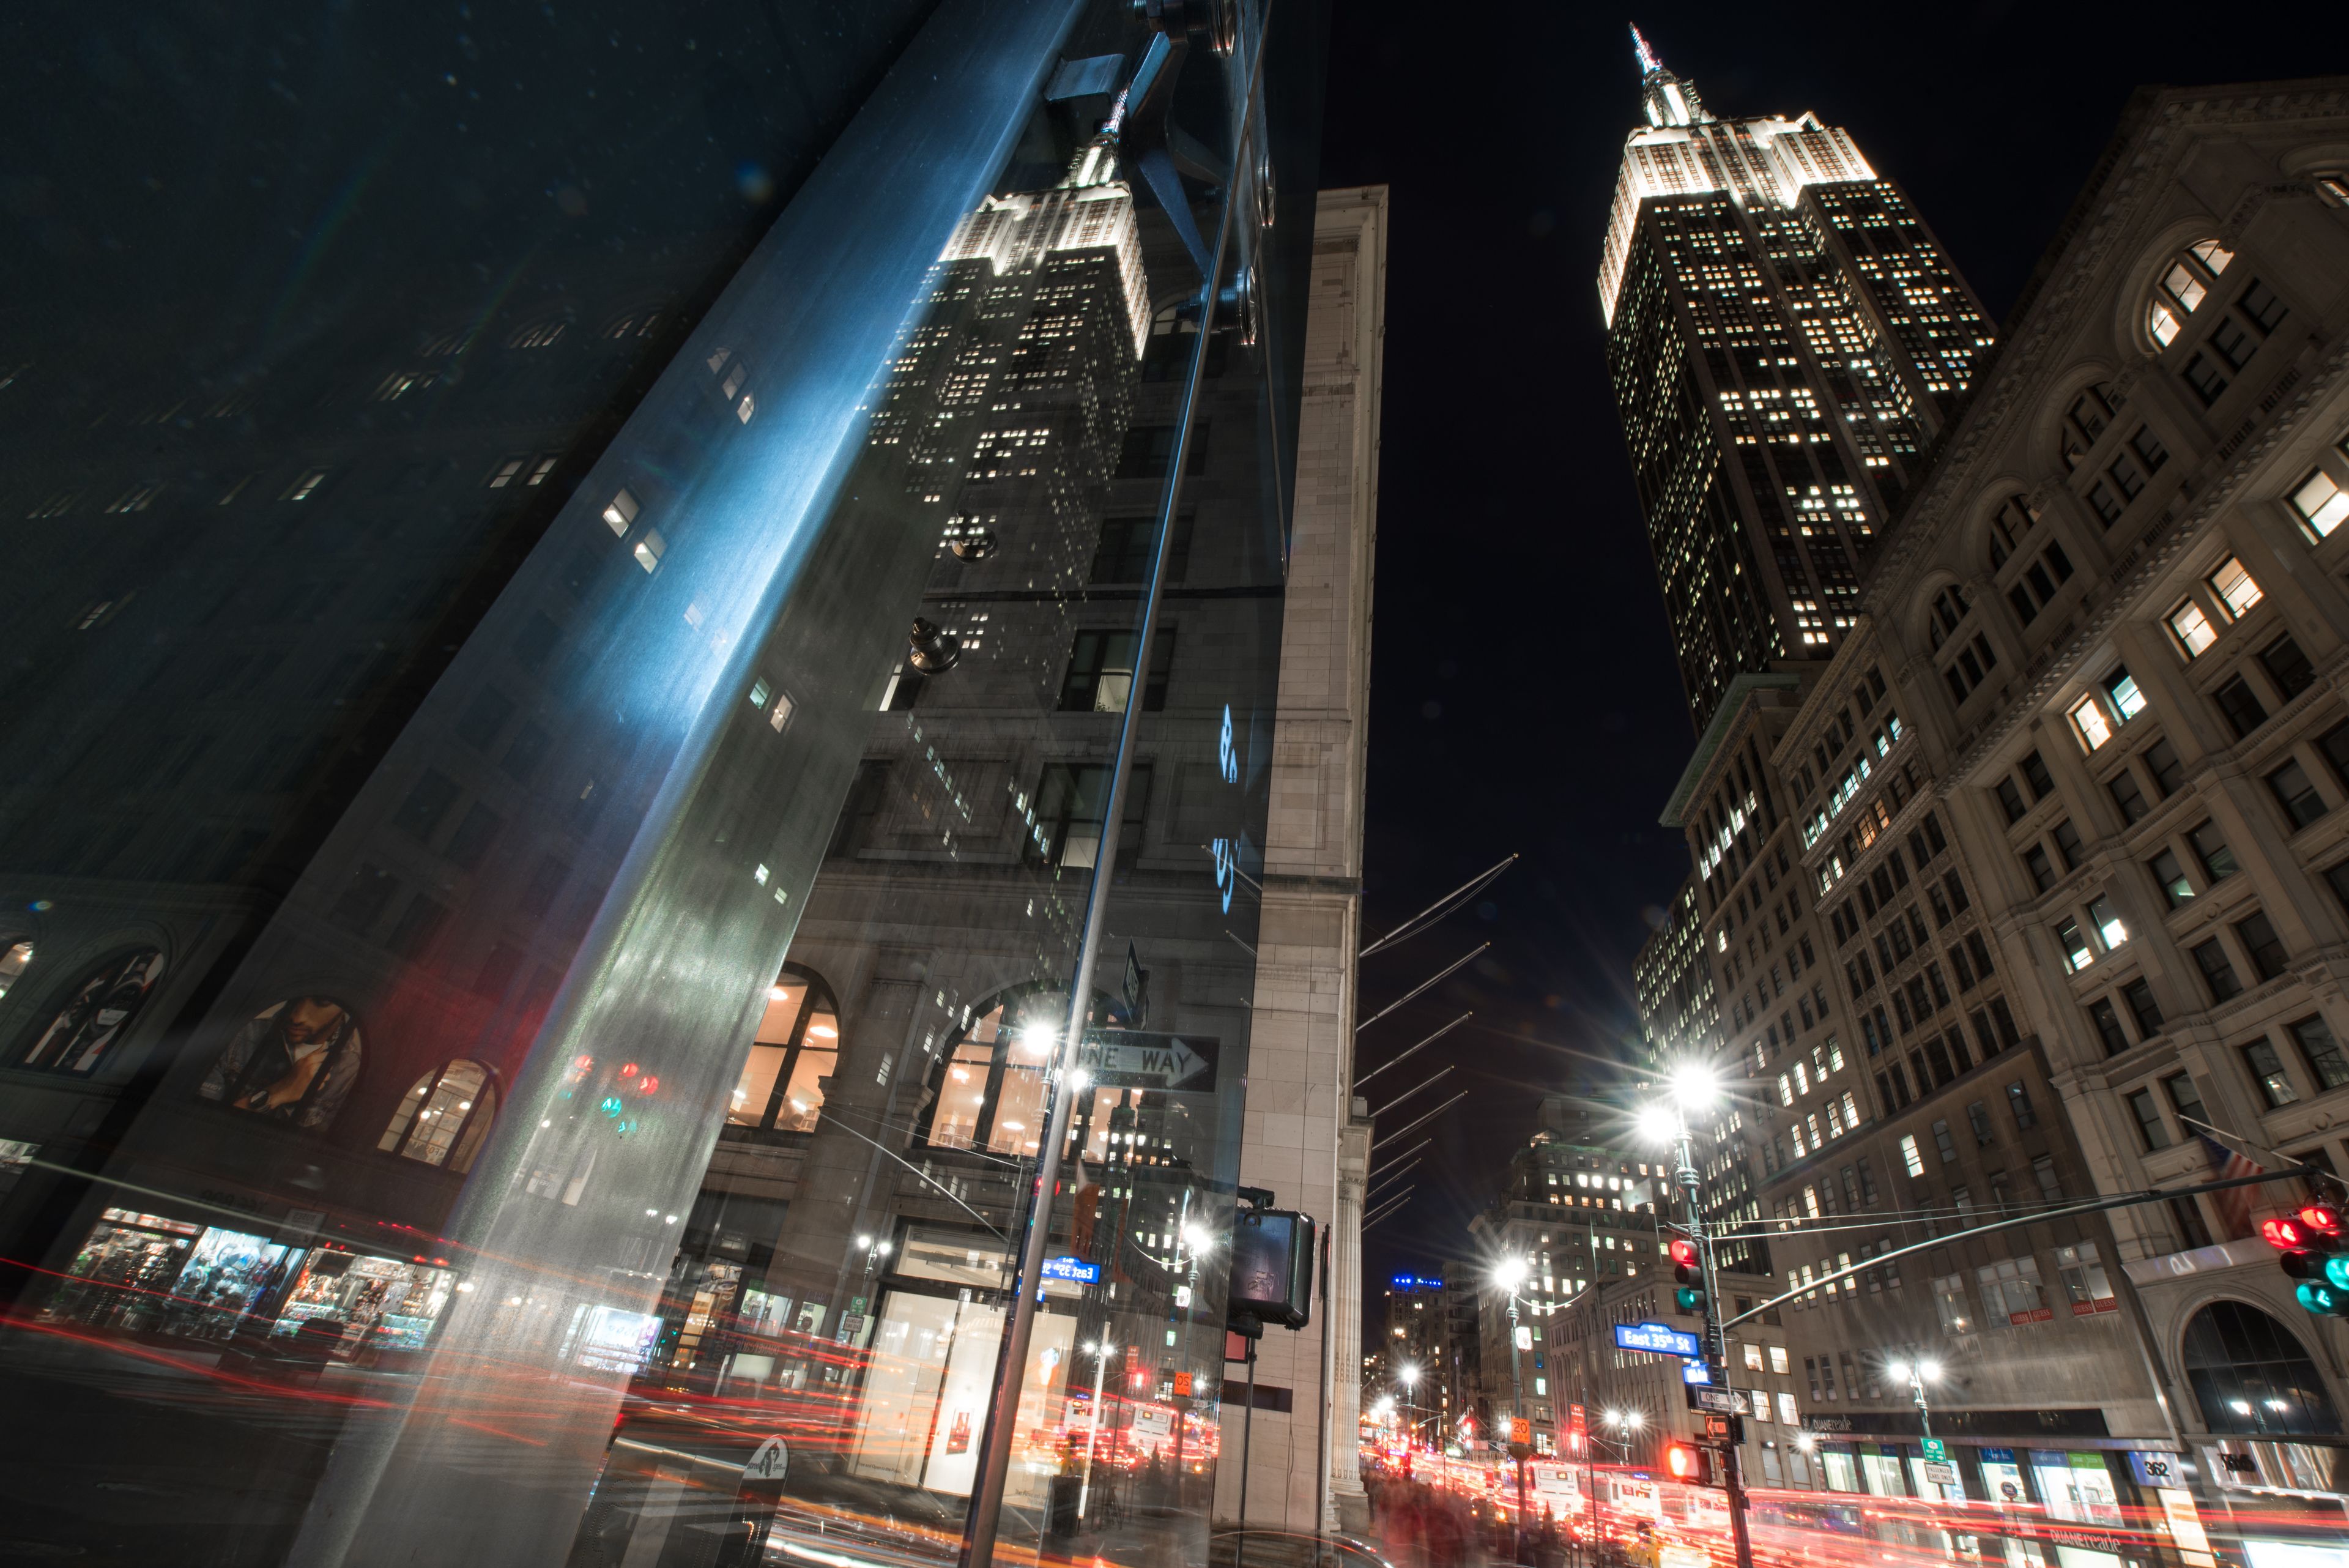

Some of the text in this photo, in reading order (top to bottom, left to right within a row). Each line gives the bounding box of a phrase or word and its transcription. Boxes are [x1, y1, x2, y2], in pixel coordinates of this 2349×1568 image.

[1086, 1047, 1192, 1074] NE WAY
[2073, 1304, 2092, 1313] GUESS
[2095, 1299, 2115, 1308] GUESS
[2012, 1313, 2028, 1323] GUESS
[1624, 1330, 1691, 1351] East 35th St
[1705, 1392, 1720, 1402] ONE
[1513, 1421, 1528, 1434] 20
[2144, 1460, 2170, 1477] 362
[2049, 1528, 2123, 1554] DUANEreade
